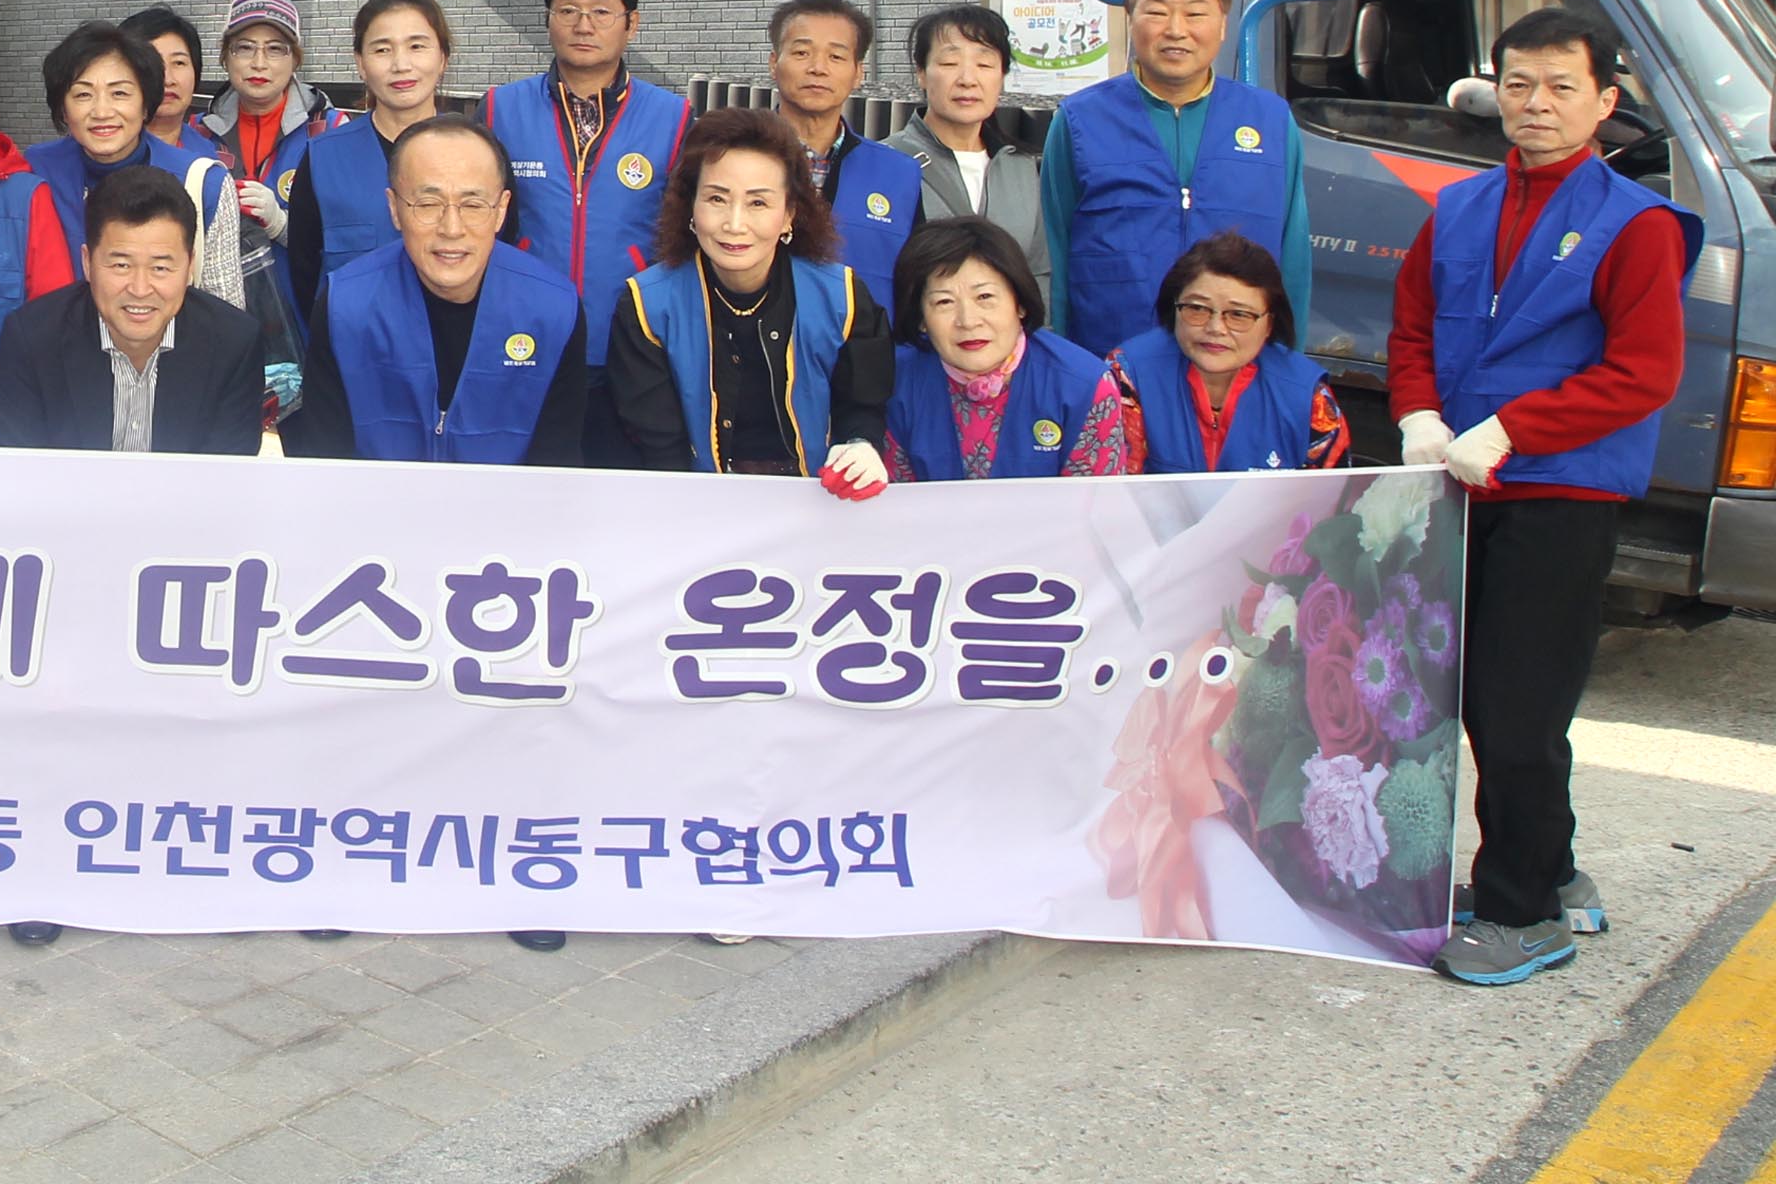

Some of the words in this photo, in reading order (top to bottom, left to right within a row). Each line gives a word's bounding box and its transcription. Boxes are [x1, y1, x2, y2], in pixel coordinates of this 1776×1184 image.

[1013, 6, 1055, 17] 아이디어
[1027, 18, 1056, 29] 공모전
[129, 550, 602, 705] 따스한
[64, 798, 916, 889] 인천광역시동구협의회
